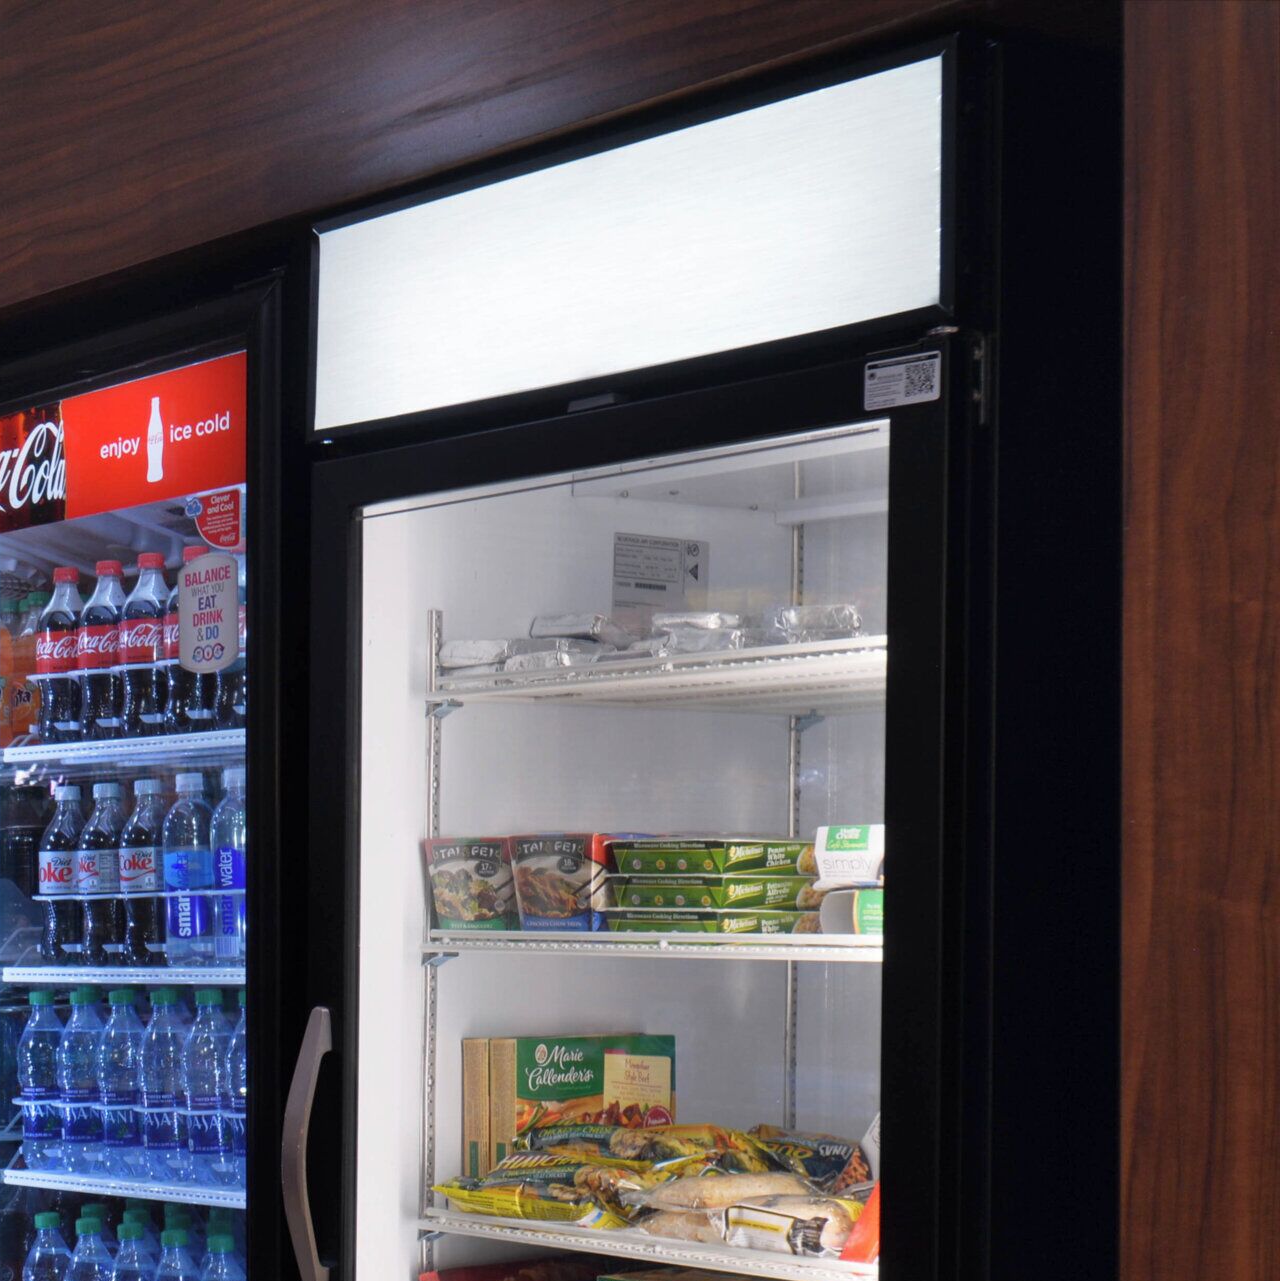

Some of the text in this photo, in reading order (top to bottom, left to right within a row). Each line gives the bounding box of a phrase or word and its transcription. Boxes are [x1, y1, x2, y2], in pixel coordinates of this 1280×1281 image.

[170, 411, 231, 443] ice cold
[100, 436, 141, 459] enjoy
[210, 493, 231, 505] Clever
[207, 501, 234, 515] and Cool
[184, 565, 231, 588] BALANCE
[191, 581, 224, 597] WHAT YOU
[198, 595, 217, 612] EAT
[192, 609, 224, 628] DRINK
[196, 629, 204, 642] &
[205, 624, 220, 641] DO
[439, 846, 494, 860] TAI PEI
[522, 840, 578, 854] TAI PEI
[51, 856, 72, 867] Diet
[221, 849, 234, 888] water
[823, 857, 872, 871] simply
[546, 1043, 584, 1069] Marie
[525, 1066, 594, 1092] Callender's
